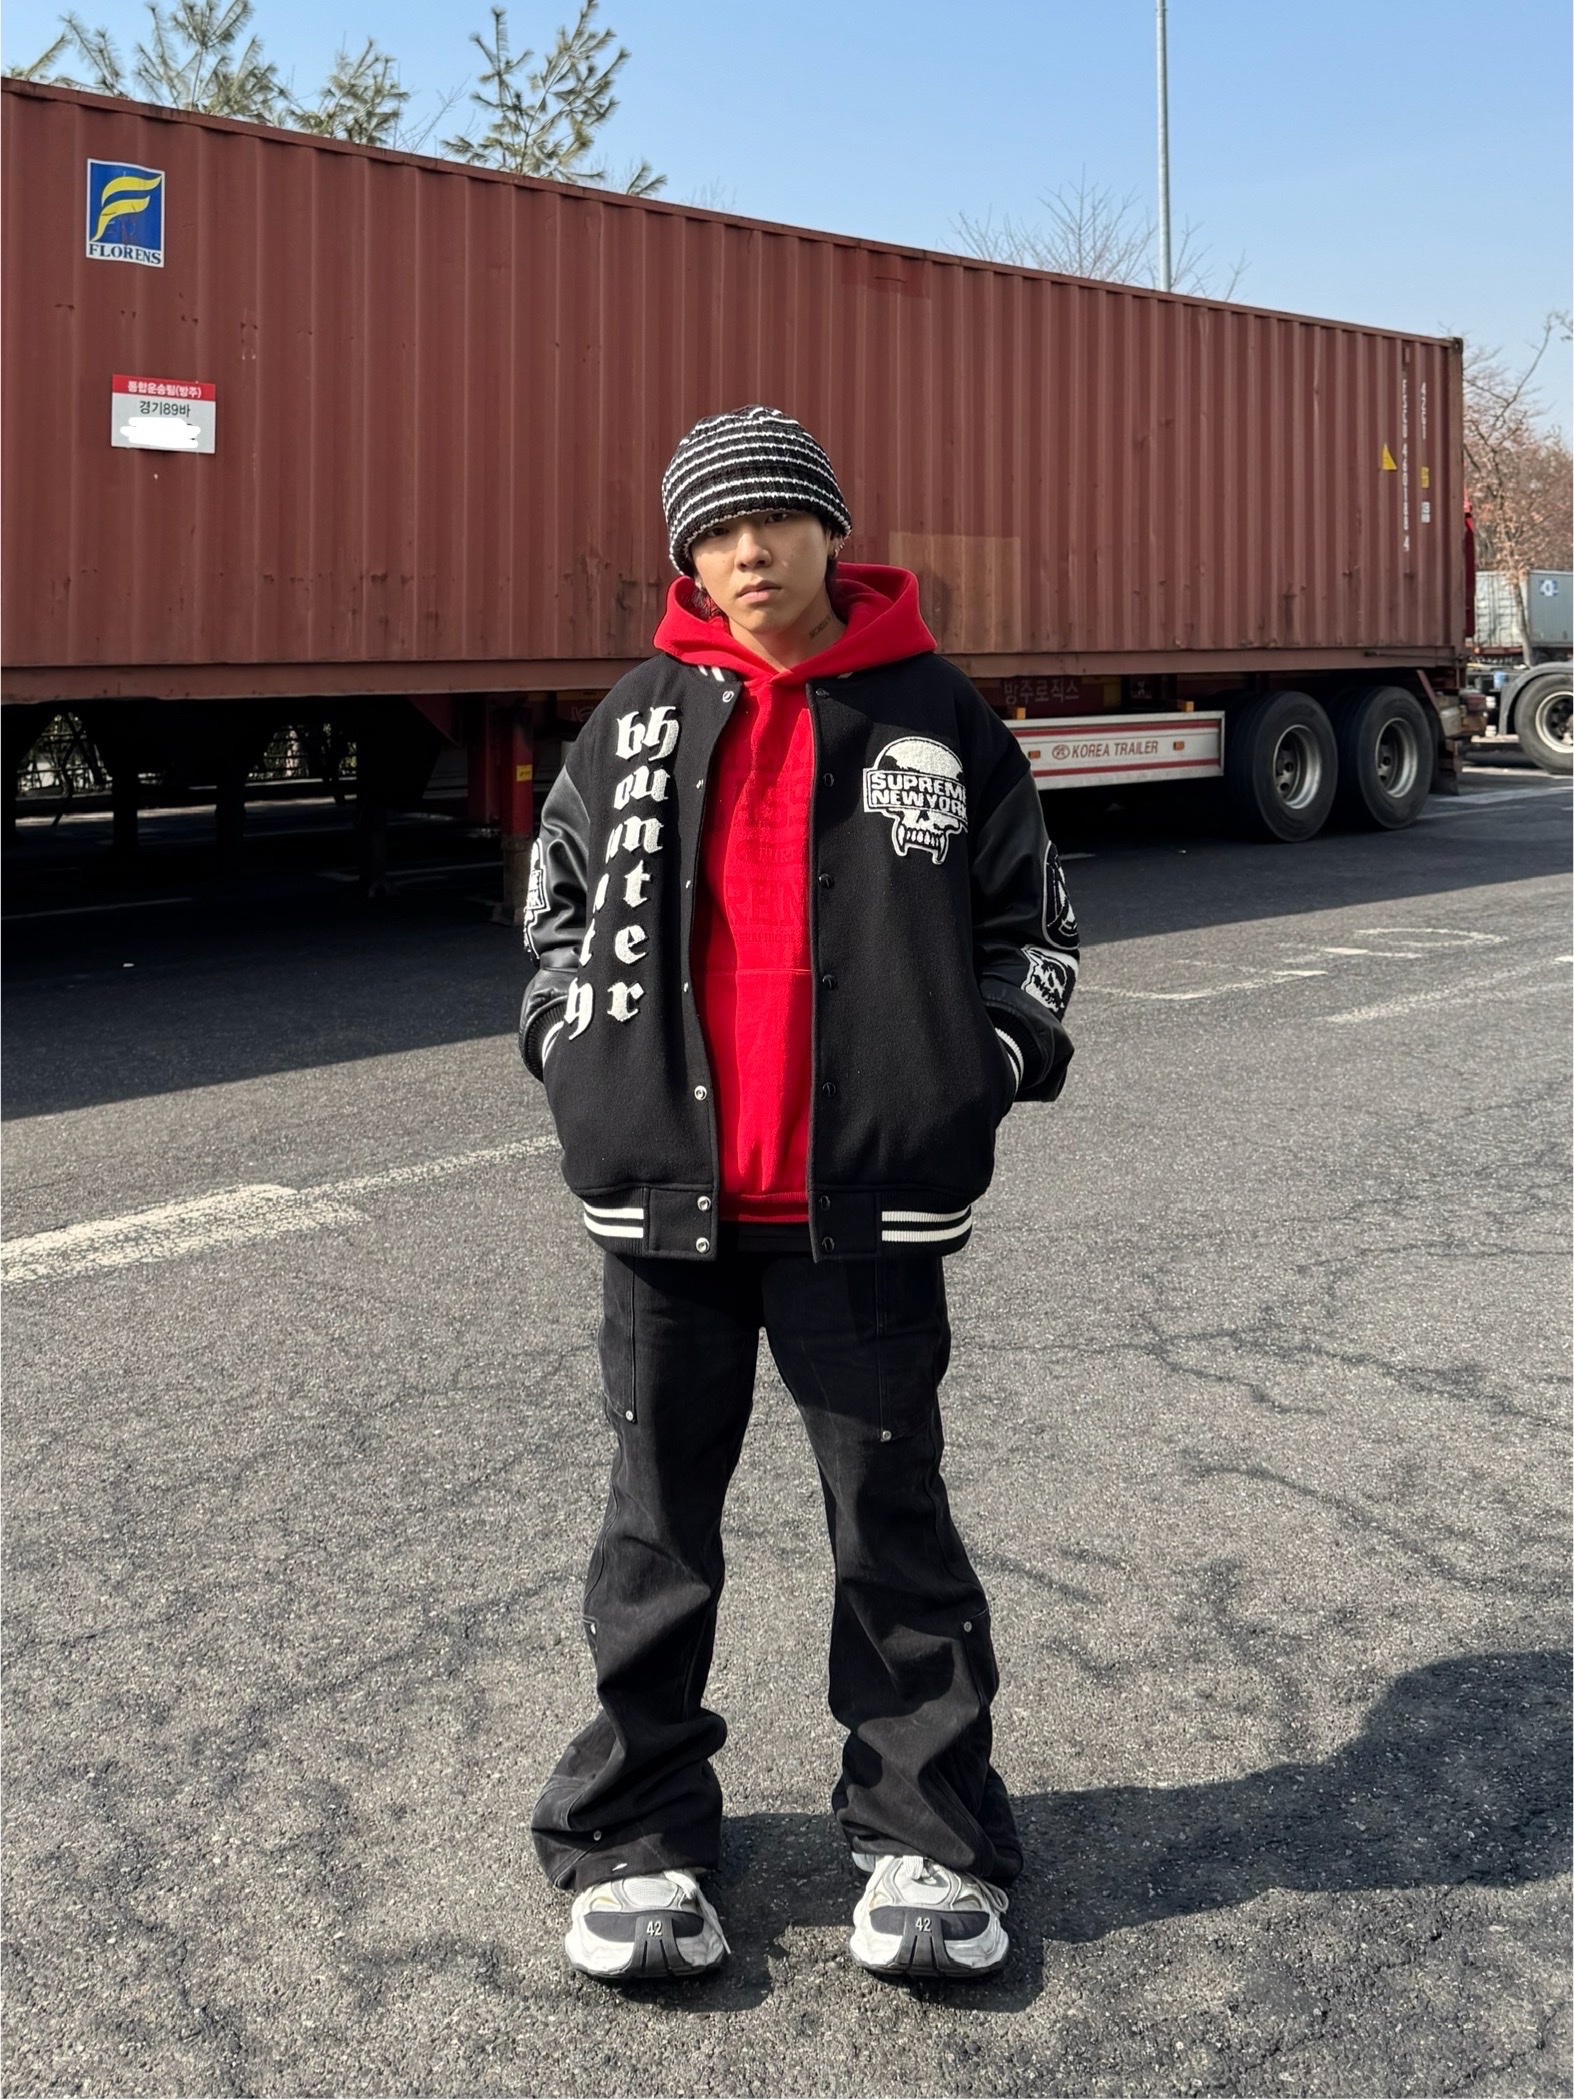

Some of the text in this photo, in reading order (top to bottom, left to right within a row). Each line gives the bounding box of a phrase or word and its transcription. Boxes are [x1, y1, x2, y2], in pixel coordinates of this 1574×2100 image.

[88, 242, 162, 265] FLORENS
[139, 400, 191, 418] 경기89바
[1004, 677, 1080, 705] 방주로직스
[1071, 740, 1159, 758] KOREA TRAILER
[871, 789, 924, 807] NEW
[646, 1919, 663, 1937] 42
[914, 1916, 932, 1934] 42
